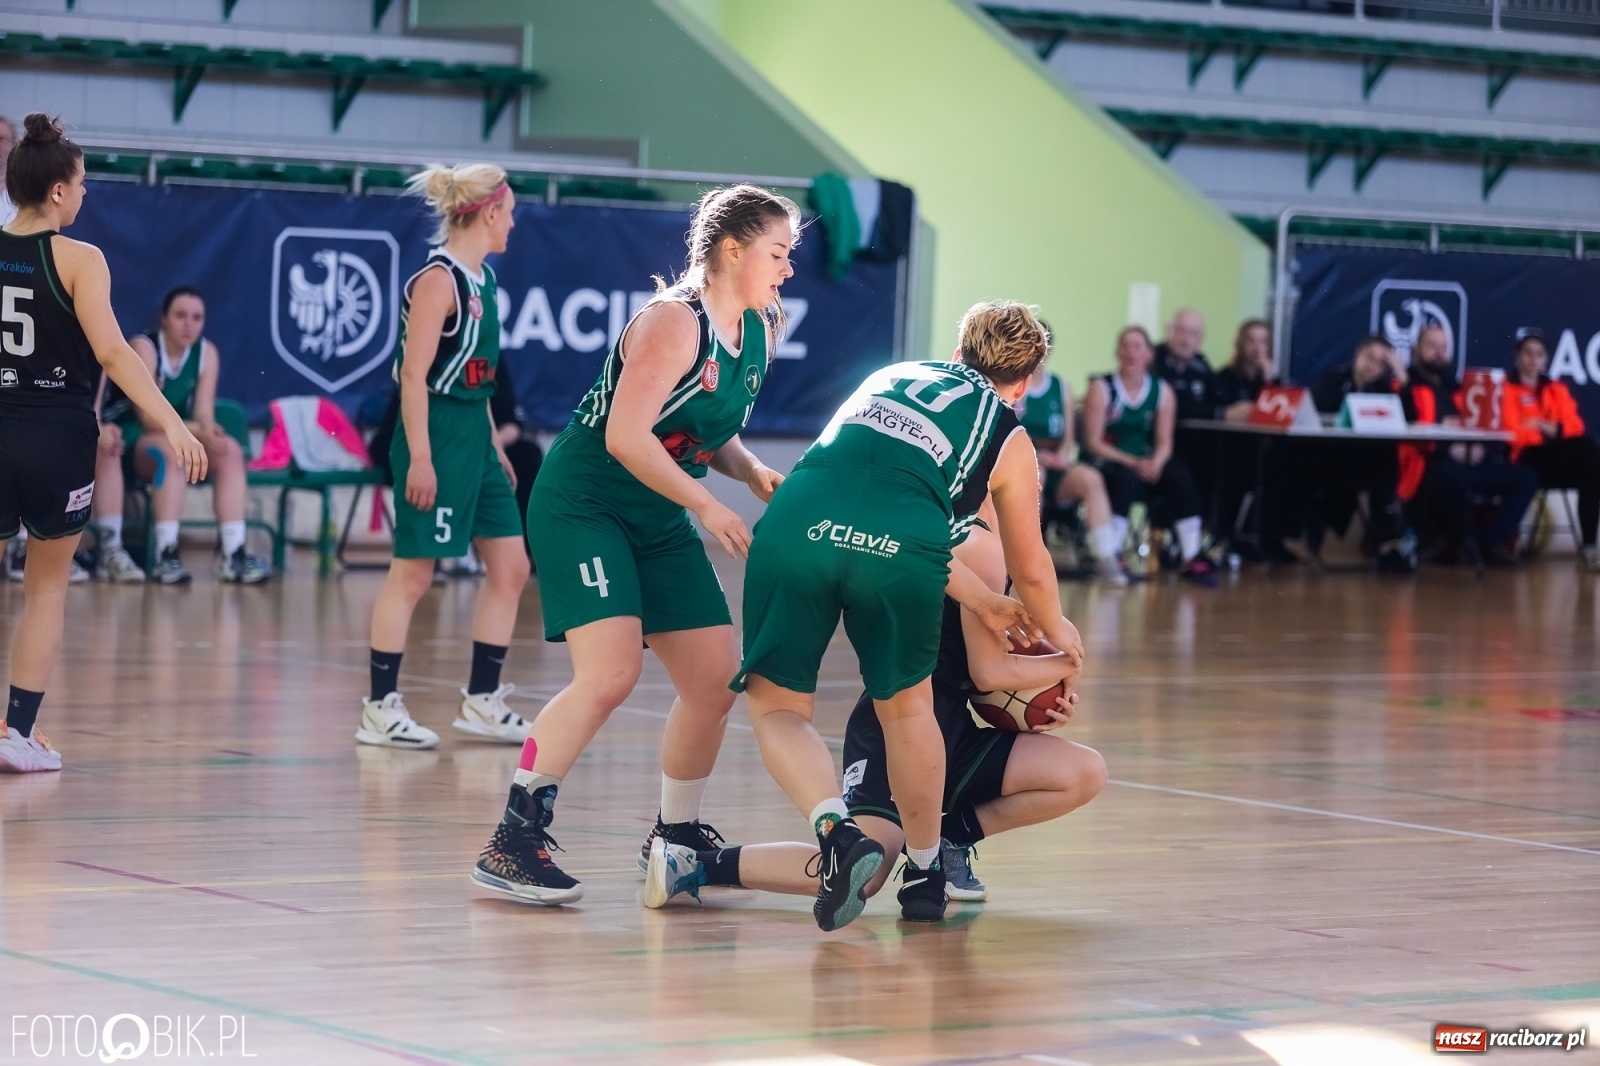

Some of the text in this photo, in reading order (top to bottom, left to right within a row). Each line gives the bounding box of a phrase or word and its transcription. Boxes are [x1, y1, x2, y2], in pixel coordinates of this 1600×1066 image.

[0, 285, 35, 357] 5
[434, 507, 453, 543] 5
[829, 524, 901, 554] Clavis
[579, 556, 609, 598] 4
